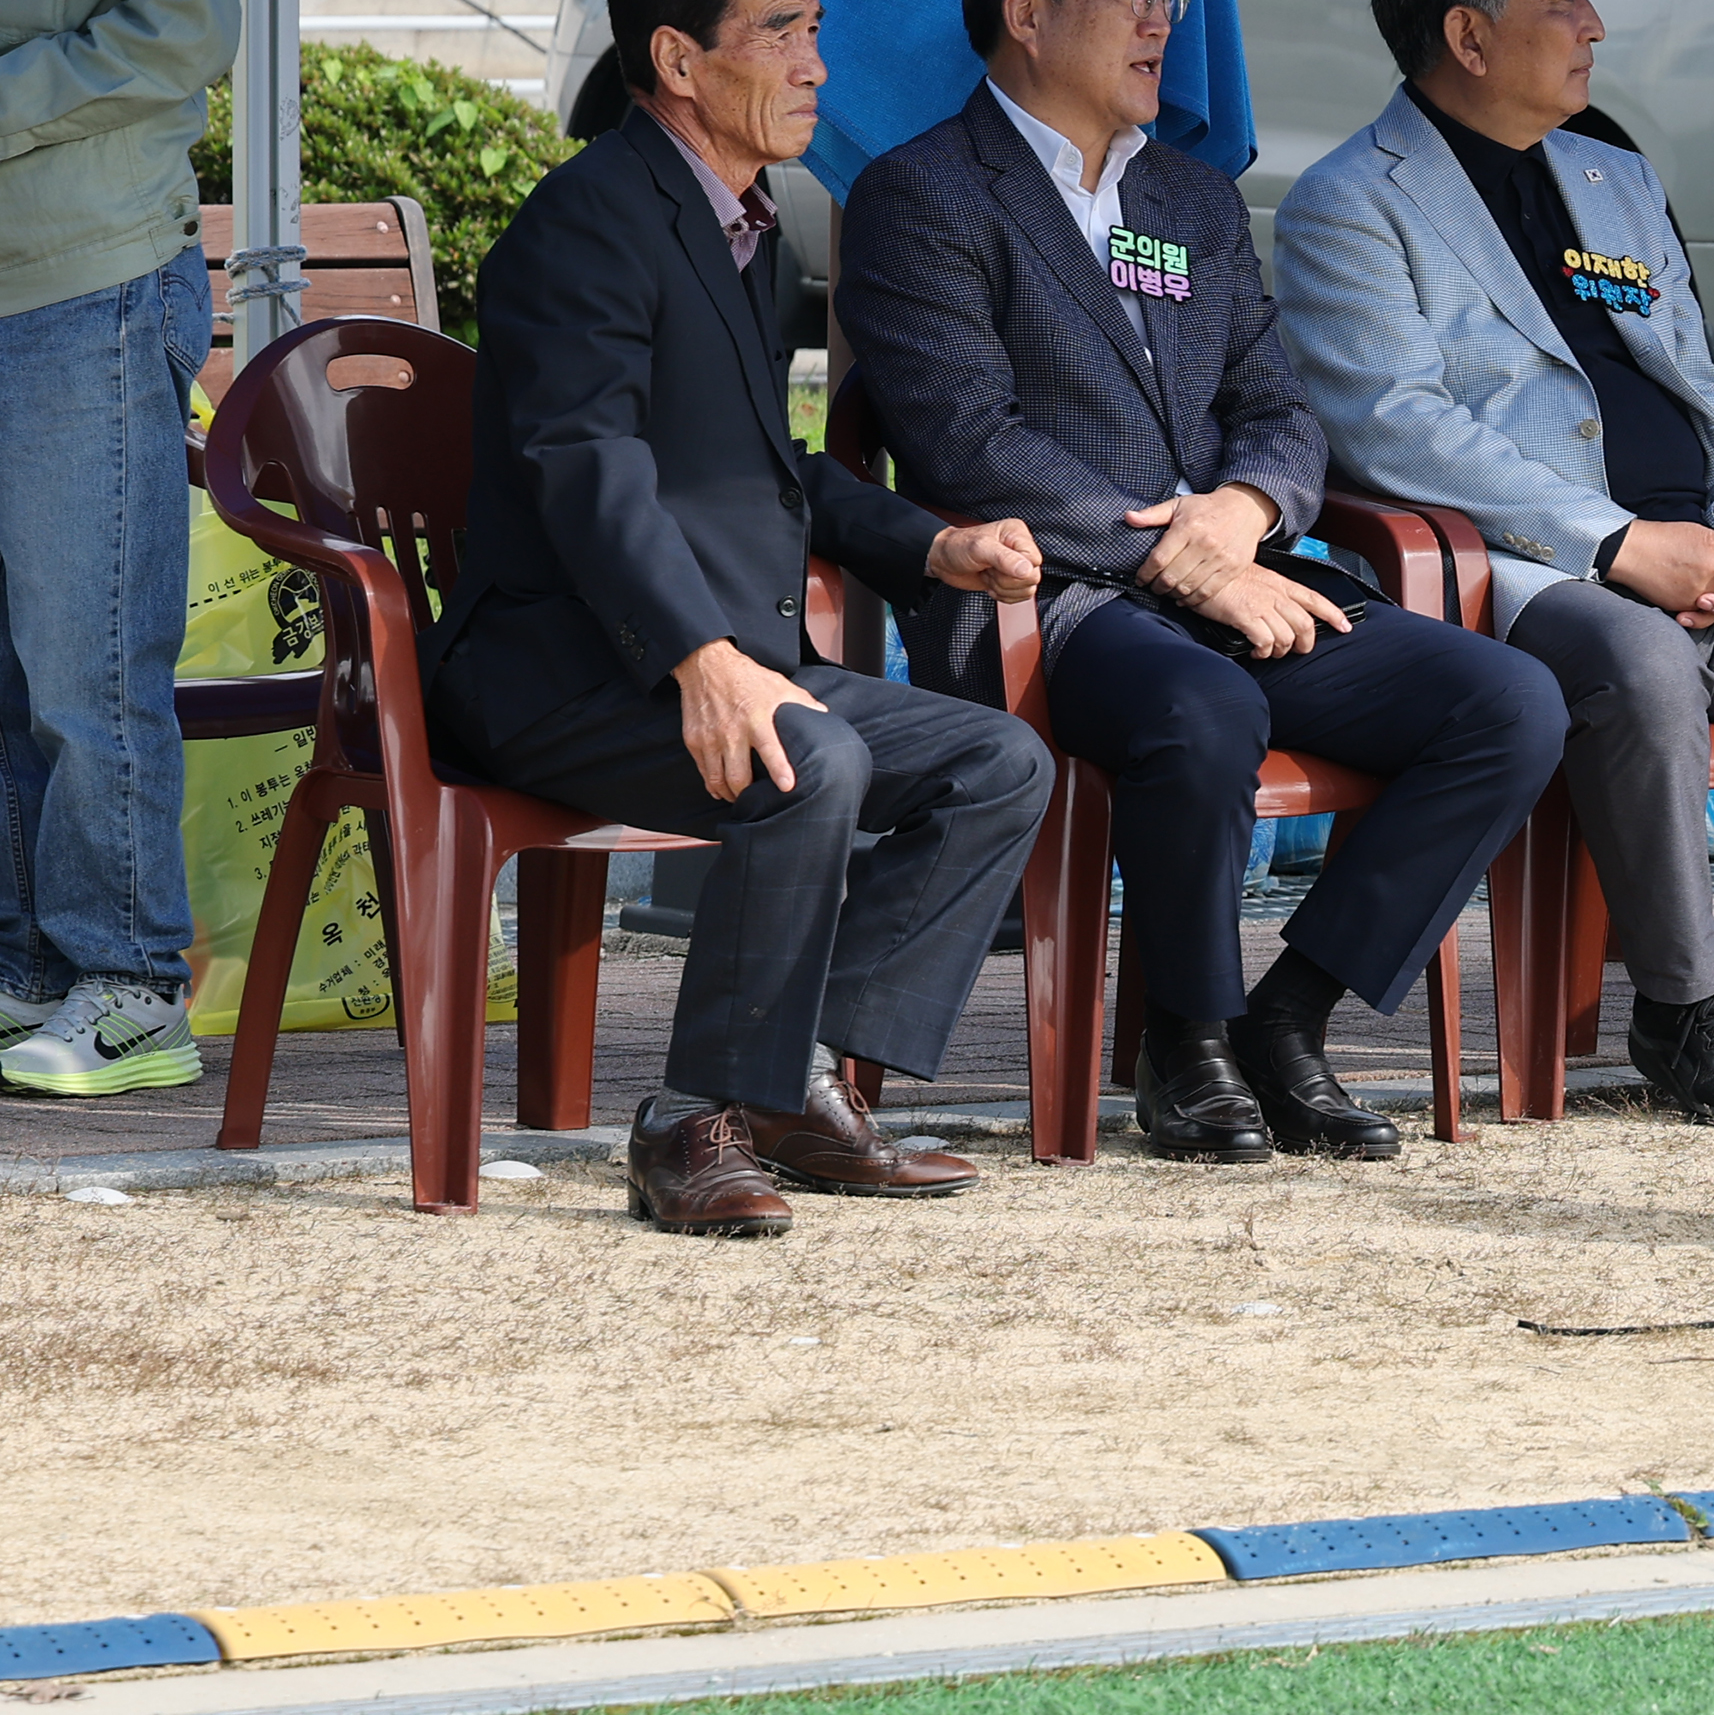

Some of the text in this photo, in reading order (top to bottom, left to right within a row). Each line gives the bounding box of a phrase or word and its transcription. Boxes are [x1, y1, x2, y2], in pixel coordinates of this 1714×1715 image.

[1109, 227, 1189, 276] 군의원
[1563, 248, 1651, 289] 이재한
[1110, 259, 1192, 302] 이병우
[1571, 273, 1653, 316] 위원장
[208, 582, 221, 593] 이
[224, 577, 236, 590] 선
[240, 788, 253, 802] 이
[255, 773, 291, 798] 봉투는
[318, 965, 354, 993] 수거업체
